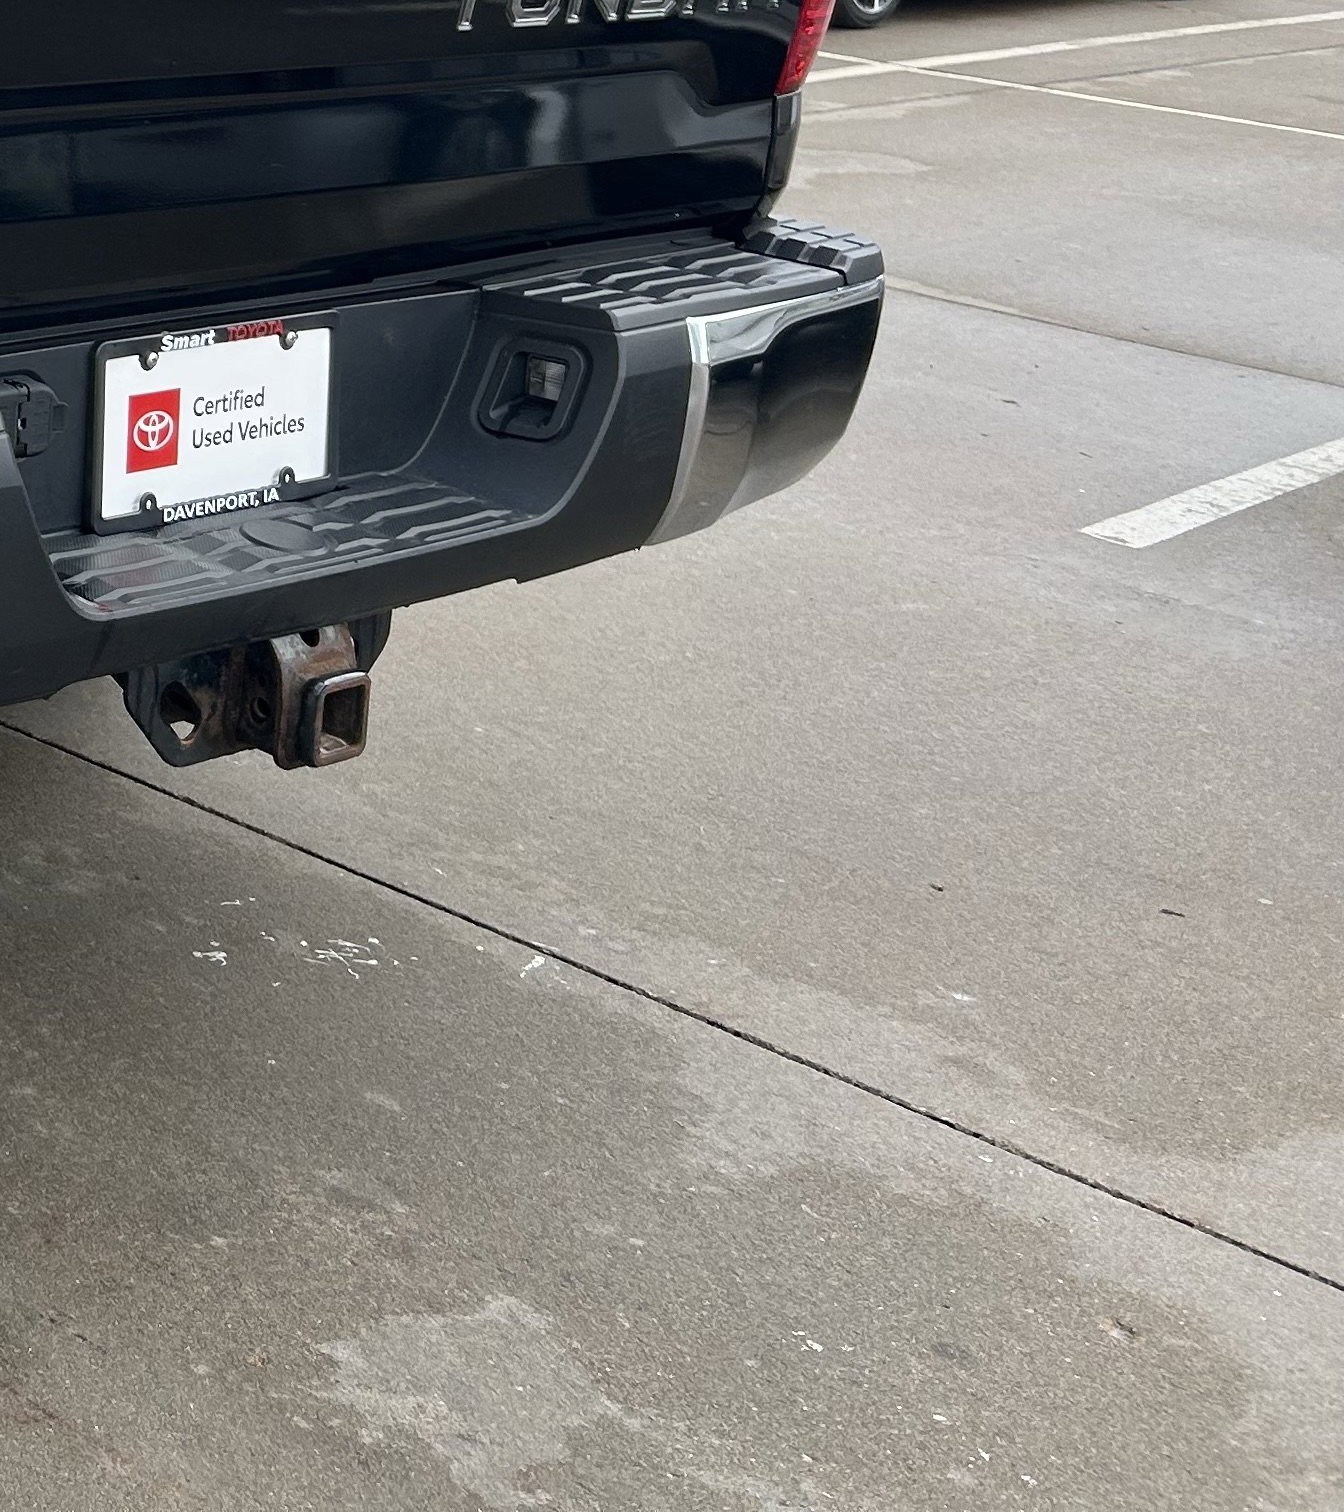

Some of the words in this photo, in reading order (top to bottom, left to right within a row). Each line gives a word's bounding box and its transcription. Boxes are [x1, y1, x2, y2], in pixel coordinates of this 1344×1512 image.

[160, 329, 216, 352] Smart
[226, 319, 285, 341] TOYOTA
[193, 385, 266, 417] Certified
[192, 423, 234, 449] Used
[238, 413, 306, 442] Vehicles
[163, 491, 261, 523] DAVENPORT,
[263, 487, 280, 502] IA
